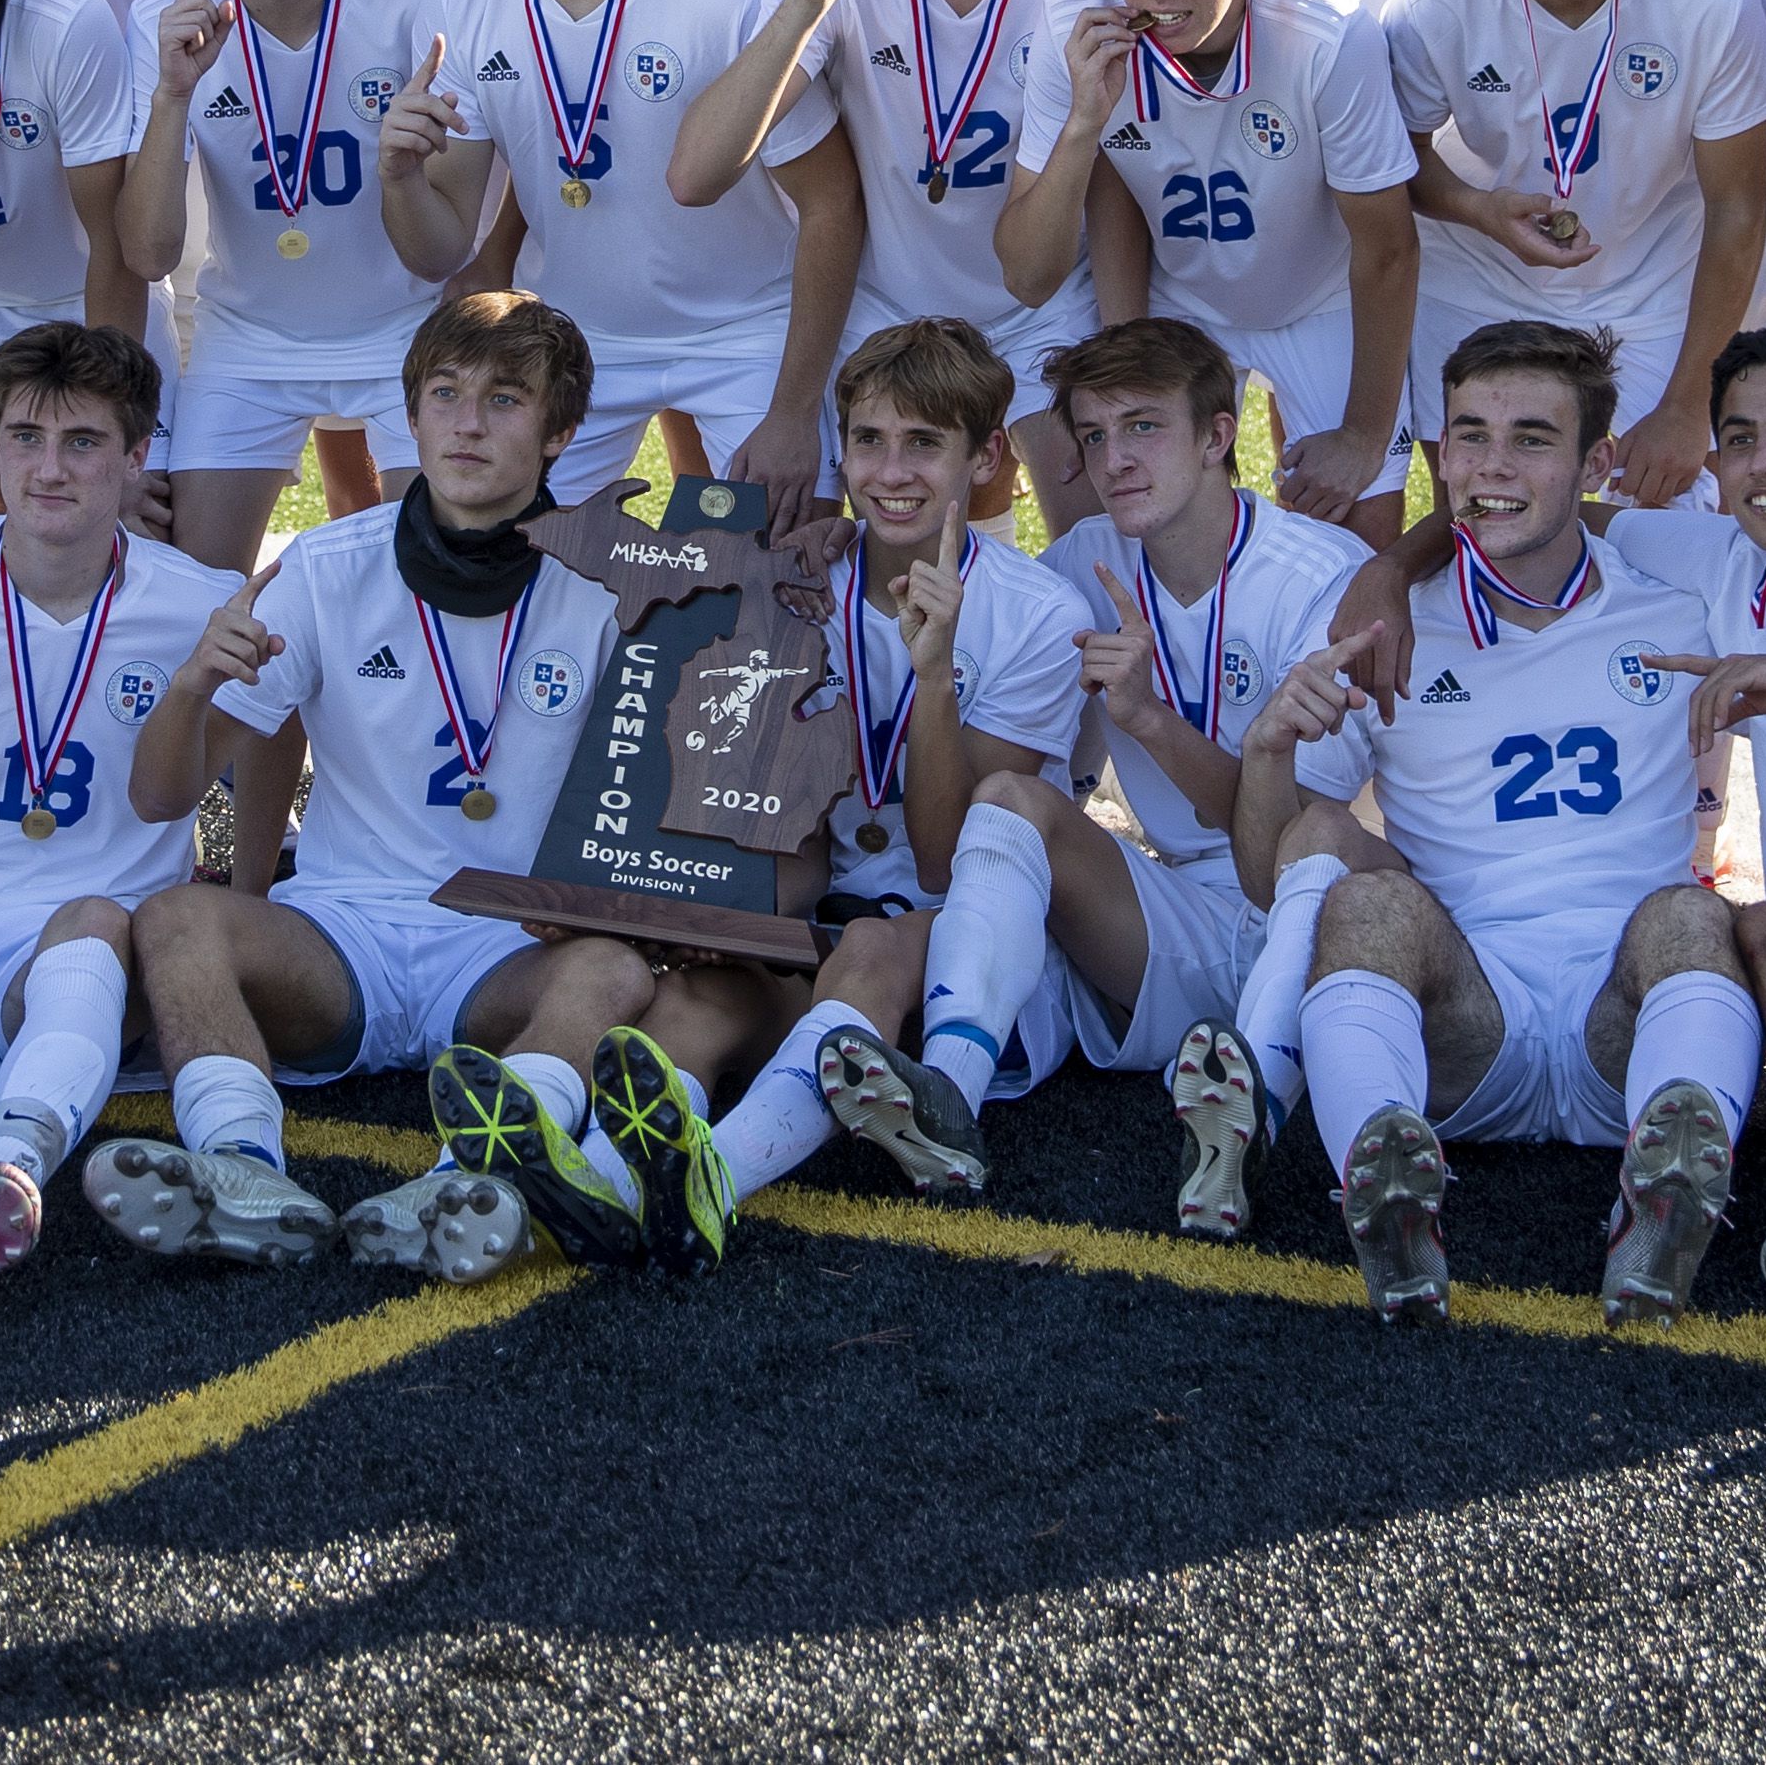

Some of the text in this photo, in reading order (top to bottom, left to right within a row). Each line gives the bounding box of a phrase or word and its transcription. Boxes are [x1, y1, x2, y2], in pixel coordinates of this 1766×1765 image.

[476, 69, 521, 82] adidas
[870, 55, 912, 76] adidas
[1466, 79, 1511, 93] adidas
[203, 105, 251, 119] adidas
[555, 102, 612, 181] 5
[1103, 137, 1152, 152] adidas
[1543, 102, 1599, 175] 9
[252, 129, 363, 211] 20
[1161, 170, 1256, 243] 26
[609, 542, 696, 568] MHSAA
[357, 665, 406, 680] adidas
[1420, 690, 1471, 704] adidas
[594, 643, 659, 836] CHAMPION
[426, 718, 488, 806] 2
[1491, 726, 1622, 823] 23
[701, 786, 782, 816] 2020
[581, 839, 733, 882] Boys Soccer
[610, 871, 696, 895] DIVISION 1
